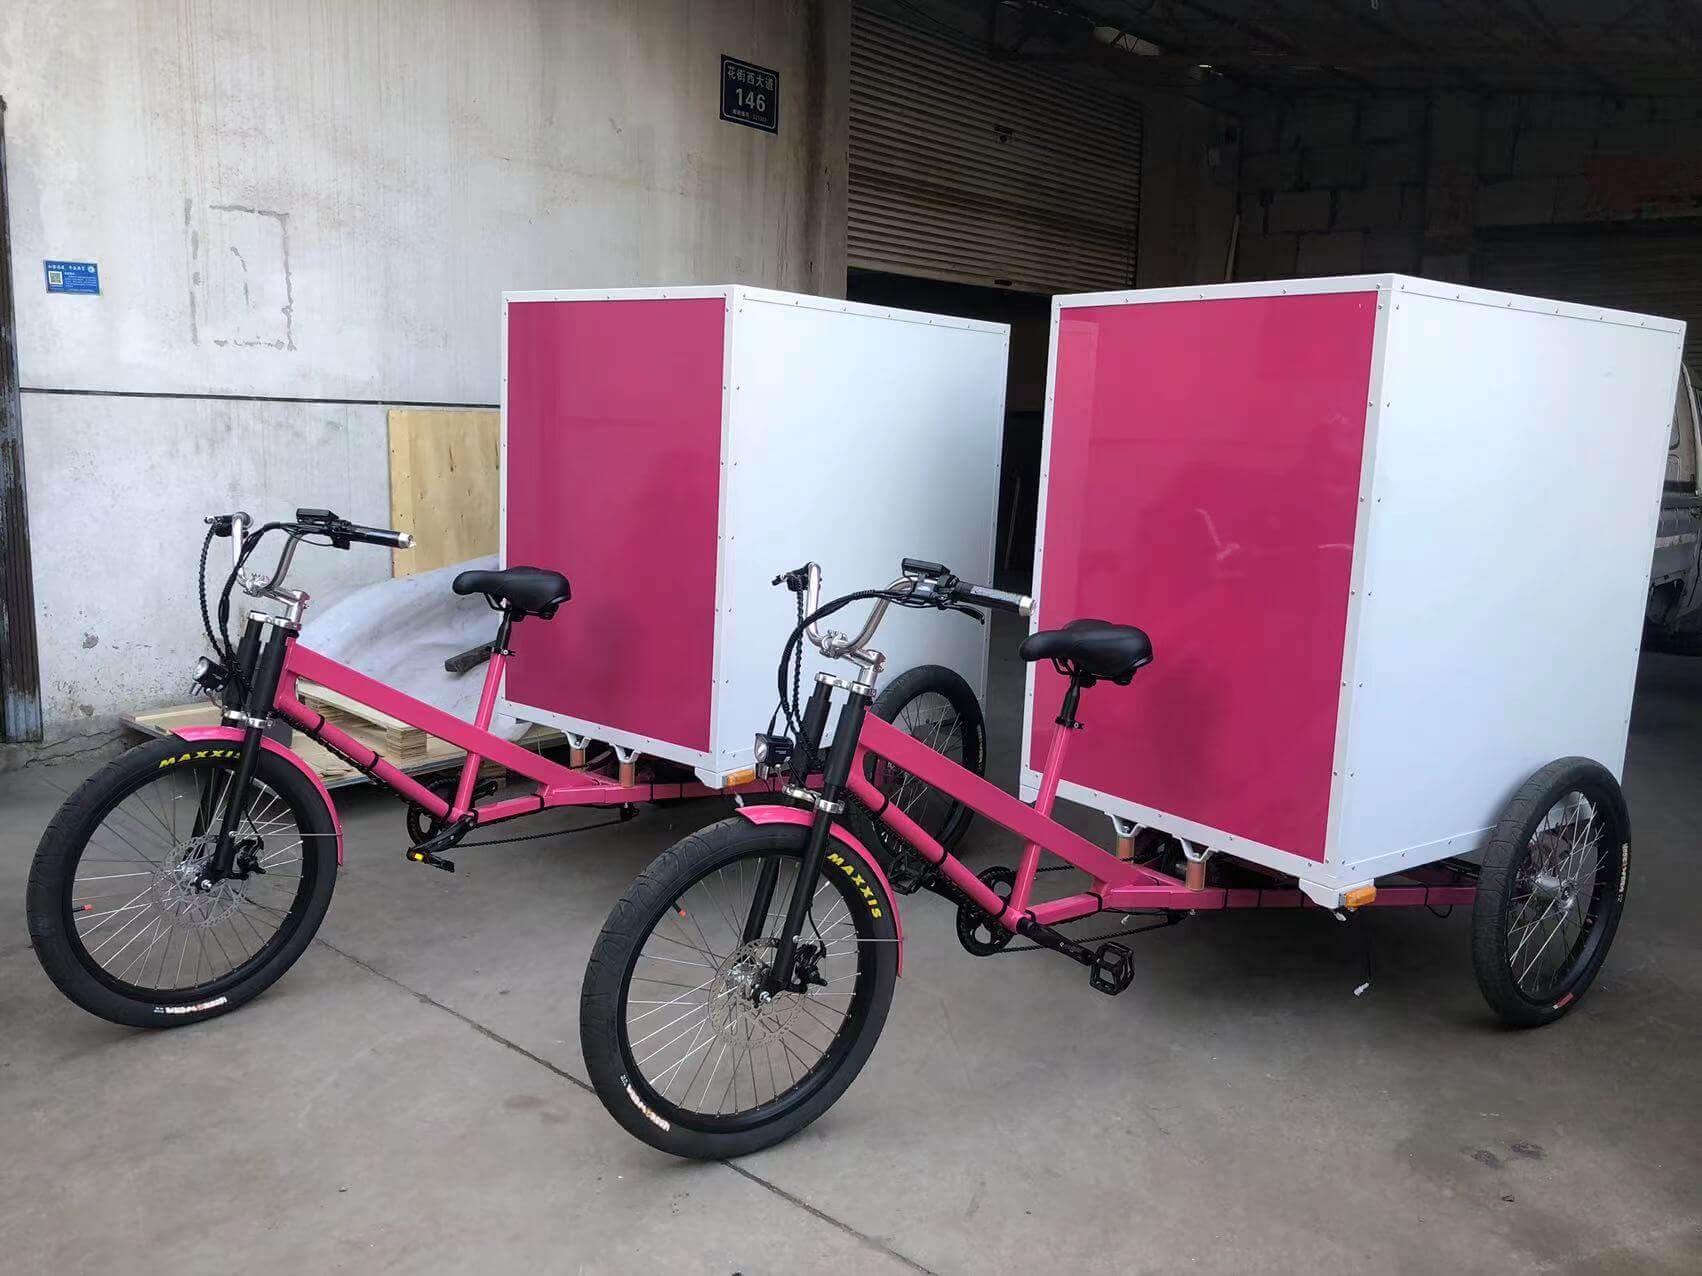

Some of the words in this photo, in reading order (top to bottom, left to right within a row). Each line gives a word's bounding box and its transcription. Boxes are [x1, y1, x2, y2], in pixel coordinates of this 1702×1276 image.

[727, 65, 774, 91] 花街西大道
[736, 88, 766, 112] 146
[826, 853, 882, 918] MAXXIS
